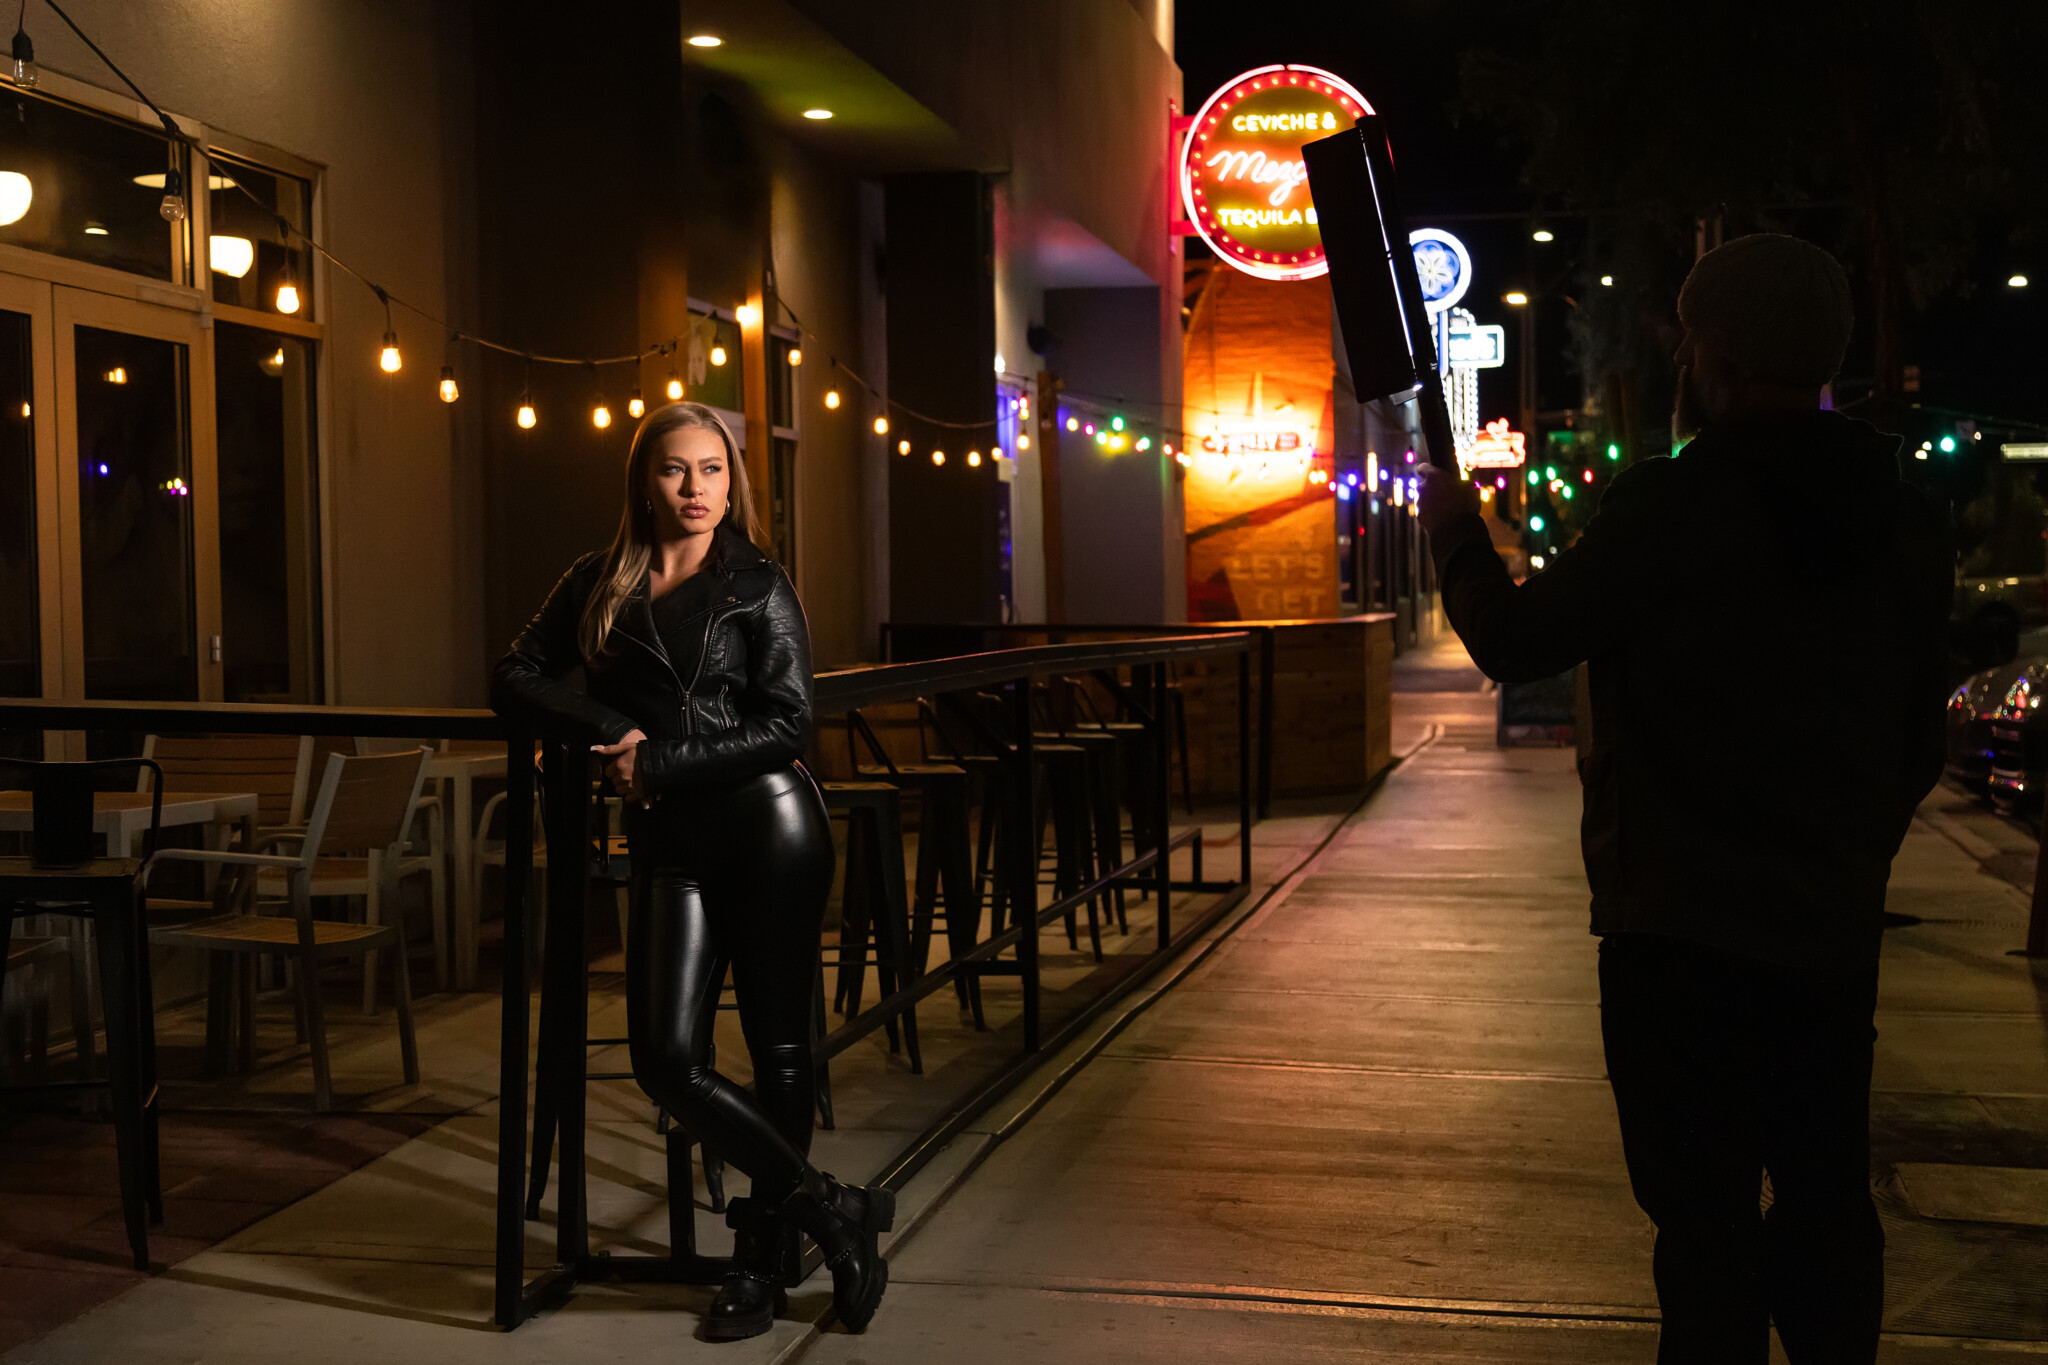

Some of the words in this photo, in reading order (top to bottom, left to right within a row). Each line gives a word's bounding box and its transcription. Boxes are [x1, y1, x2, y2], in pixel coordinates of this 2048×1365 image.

[1232, 112, 1318, 132] CEVICHE
[1321, 111, 1337, 130] &
[1217, 207, 1303, 229] TEQUILA
